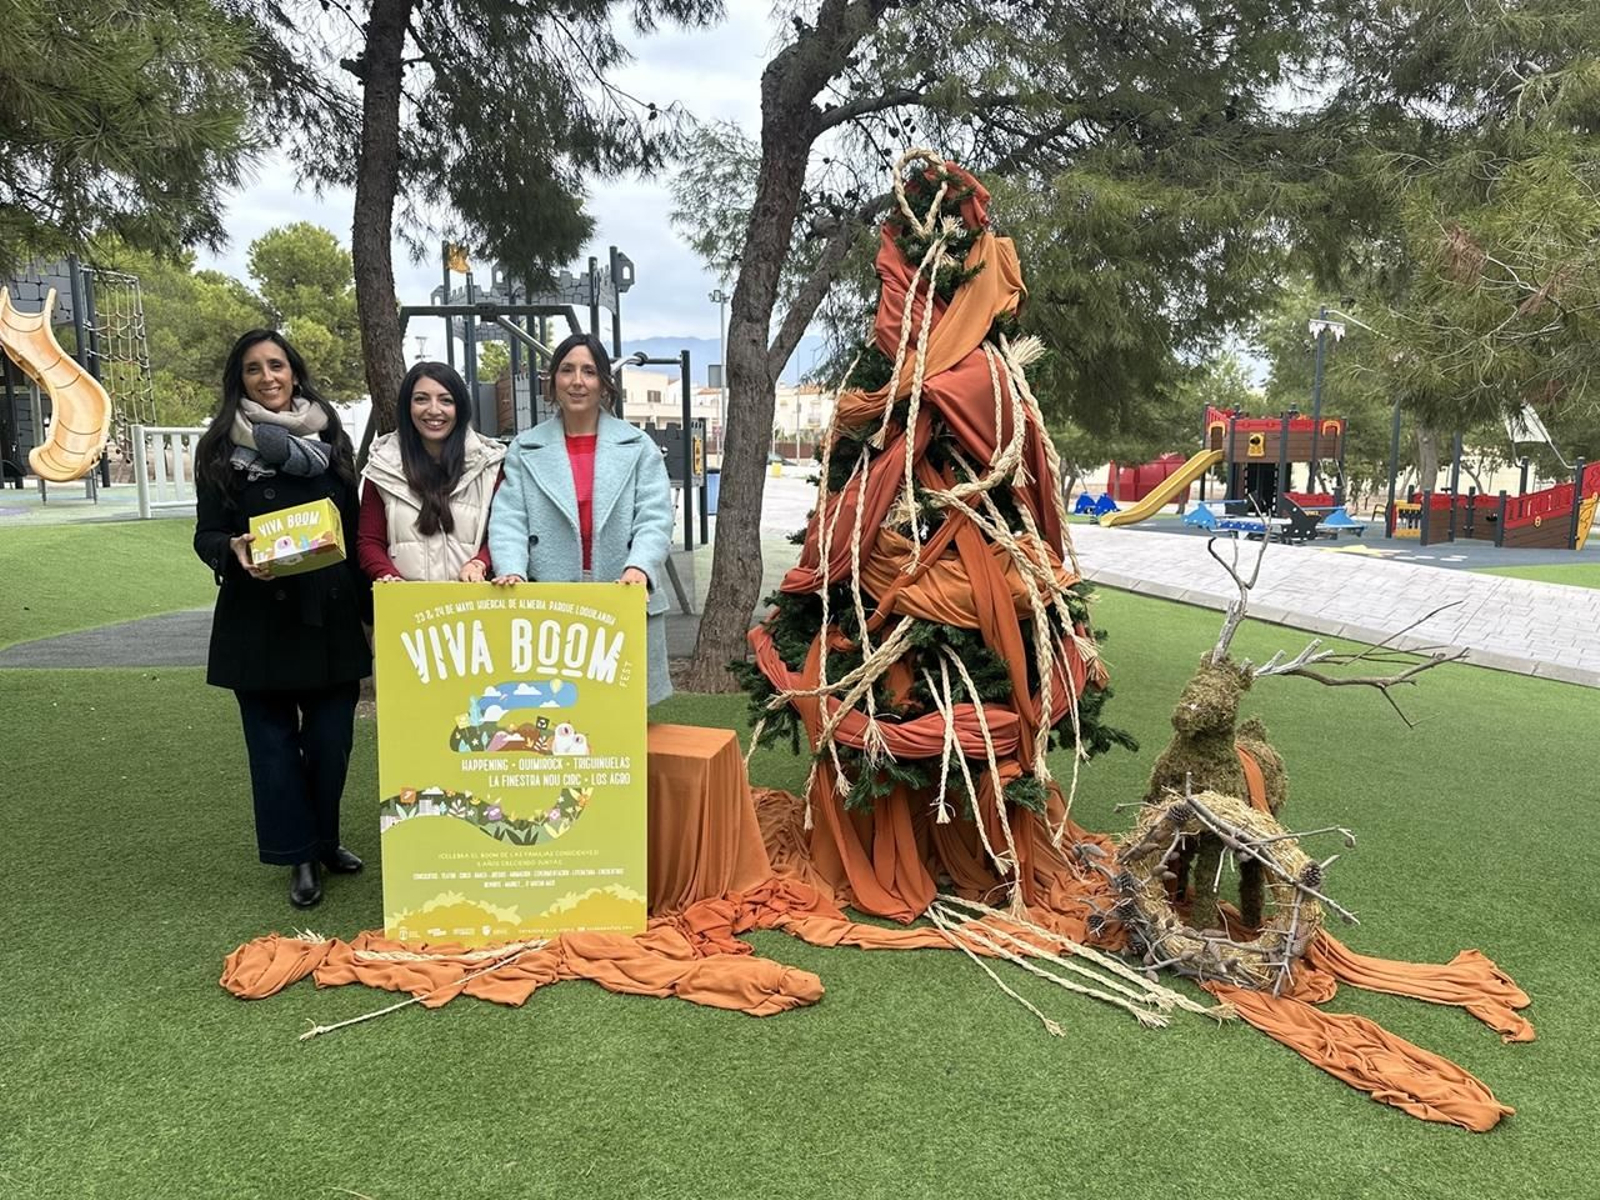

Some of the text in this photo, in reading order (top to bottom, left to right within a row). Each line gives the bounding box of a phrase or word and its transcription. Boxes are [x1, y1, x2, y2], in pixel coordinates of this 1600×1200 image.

[258, 510, 320, 537] VIVA BOOM
[455, 601, 475, 612] MAYO
[508, 598, 517, 609] DE
[549, 600, 575, 615] PARQUE
[400, 618, 625, 684] VIVA BOOM
[619, 660, 634, 688] FEST
[461, 758, 509, 771] HAPPENING
[489, 774, 500, 787] LA
[502, 774, 541, 787] FINESTRA
[543, 773, 561, 786] NOU
[591, 773, 608, 785] LOS
[609, 772, 631, 785] AGRO
